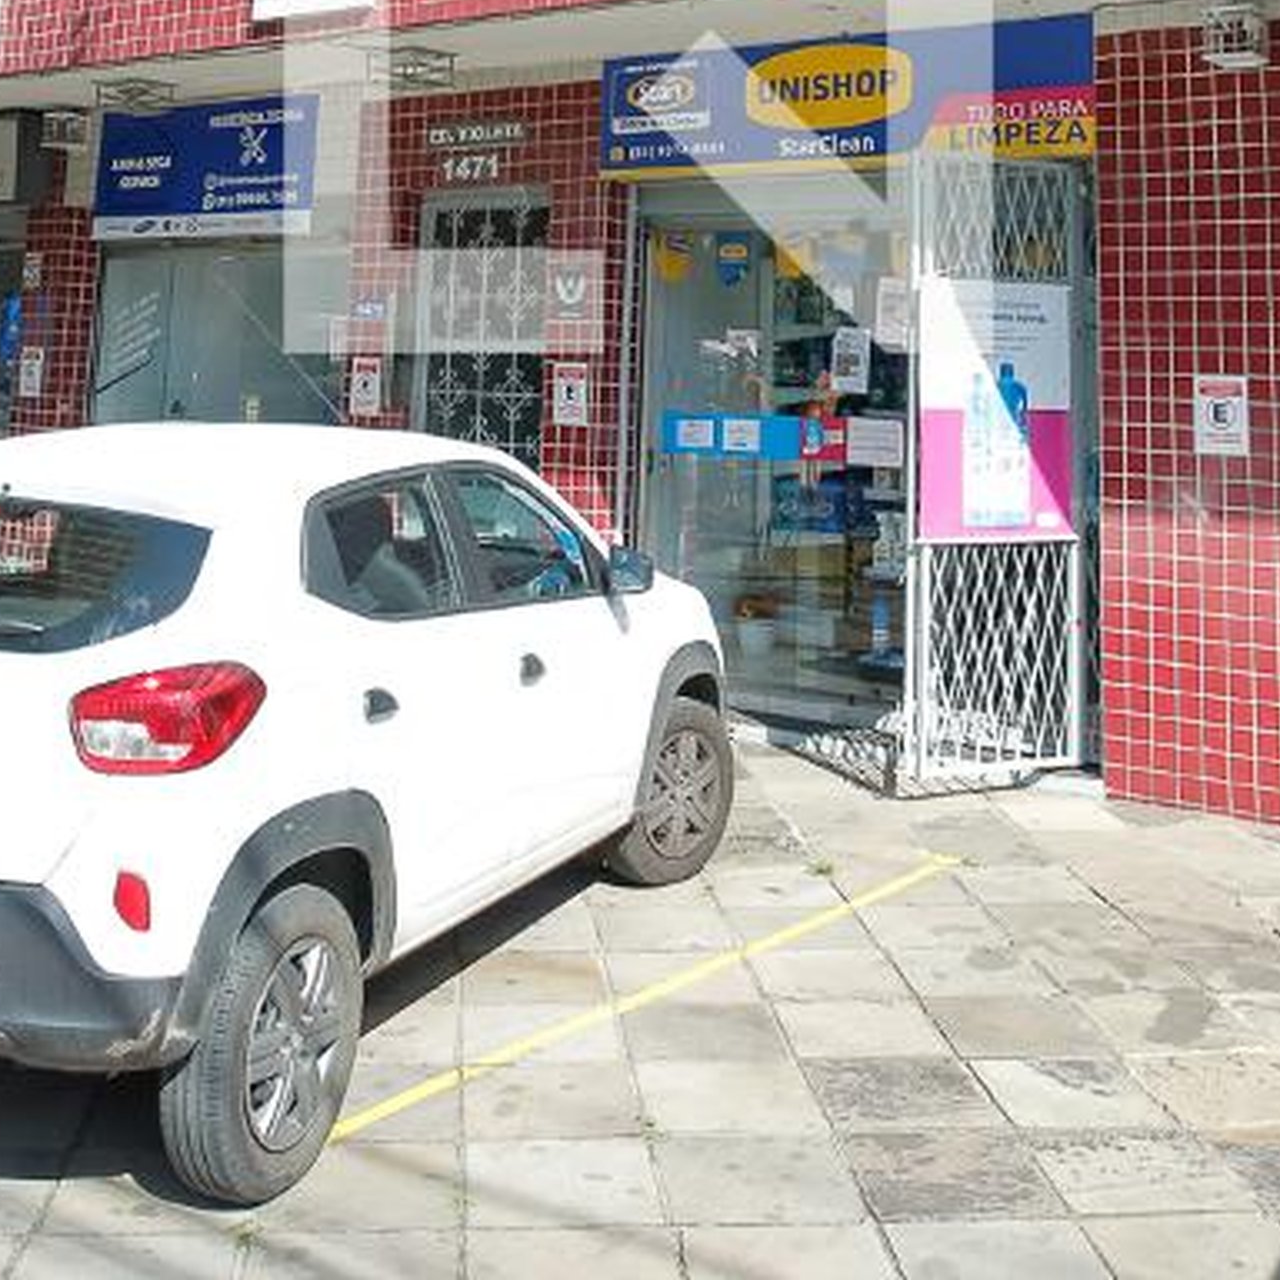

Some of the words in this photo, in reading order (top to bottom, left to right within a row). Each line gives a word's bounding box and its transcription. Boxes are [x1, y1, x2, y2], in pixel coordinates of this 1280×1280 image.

[759, 69, 897, 105] UNISHOP
[1029, 98, 1088, 120] PARA
[777, 134, 876, 158] StarClean
[948, 119, 1088, 150] LIMPEZA
[442, 153, 498, 181] 1471
